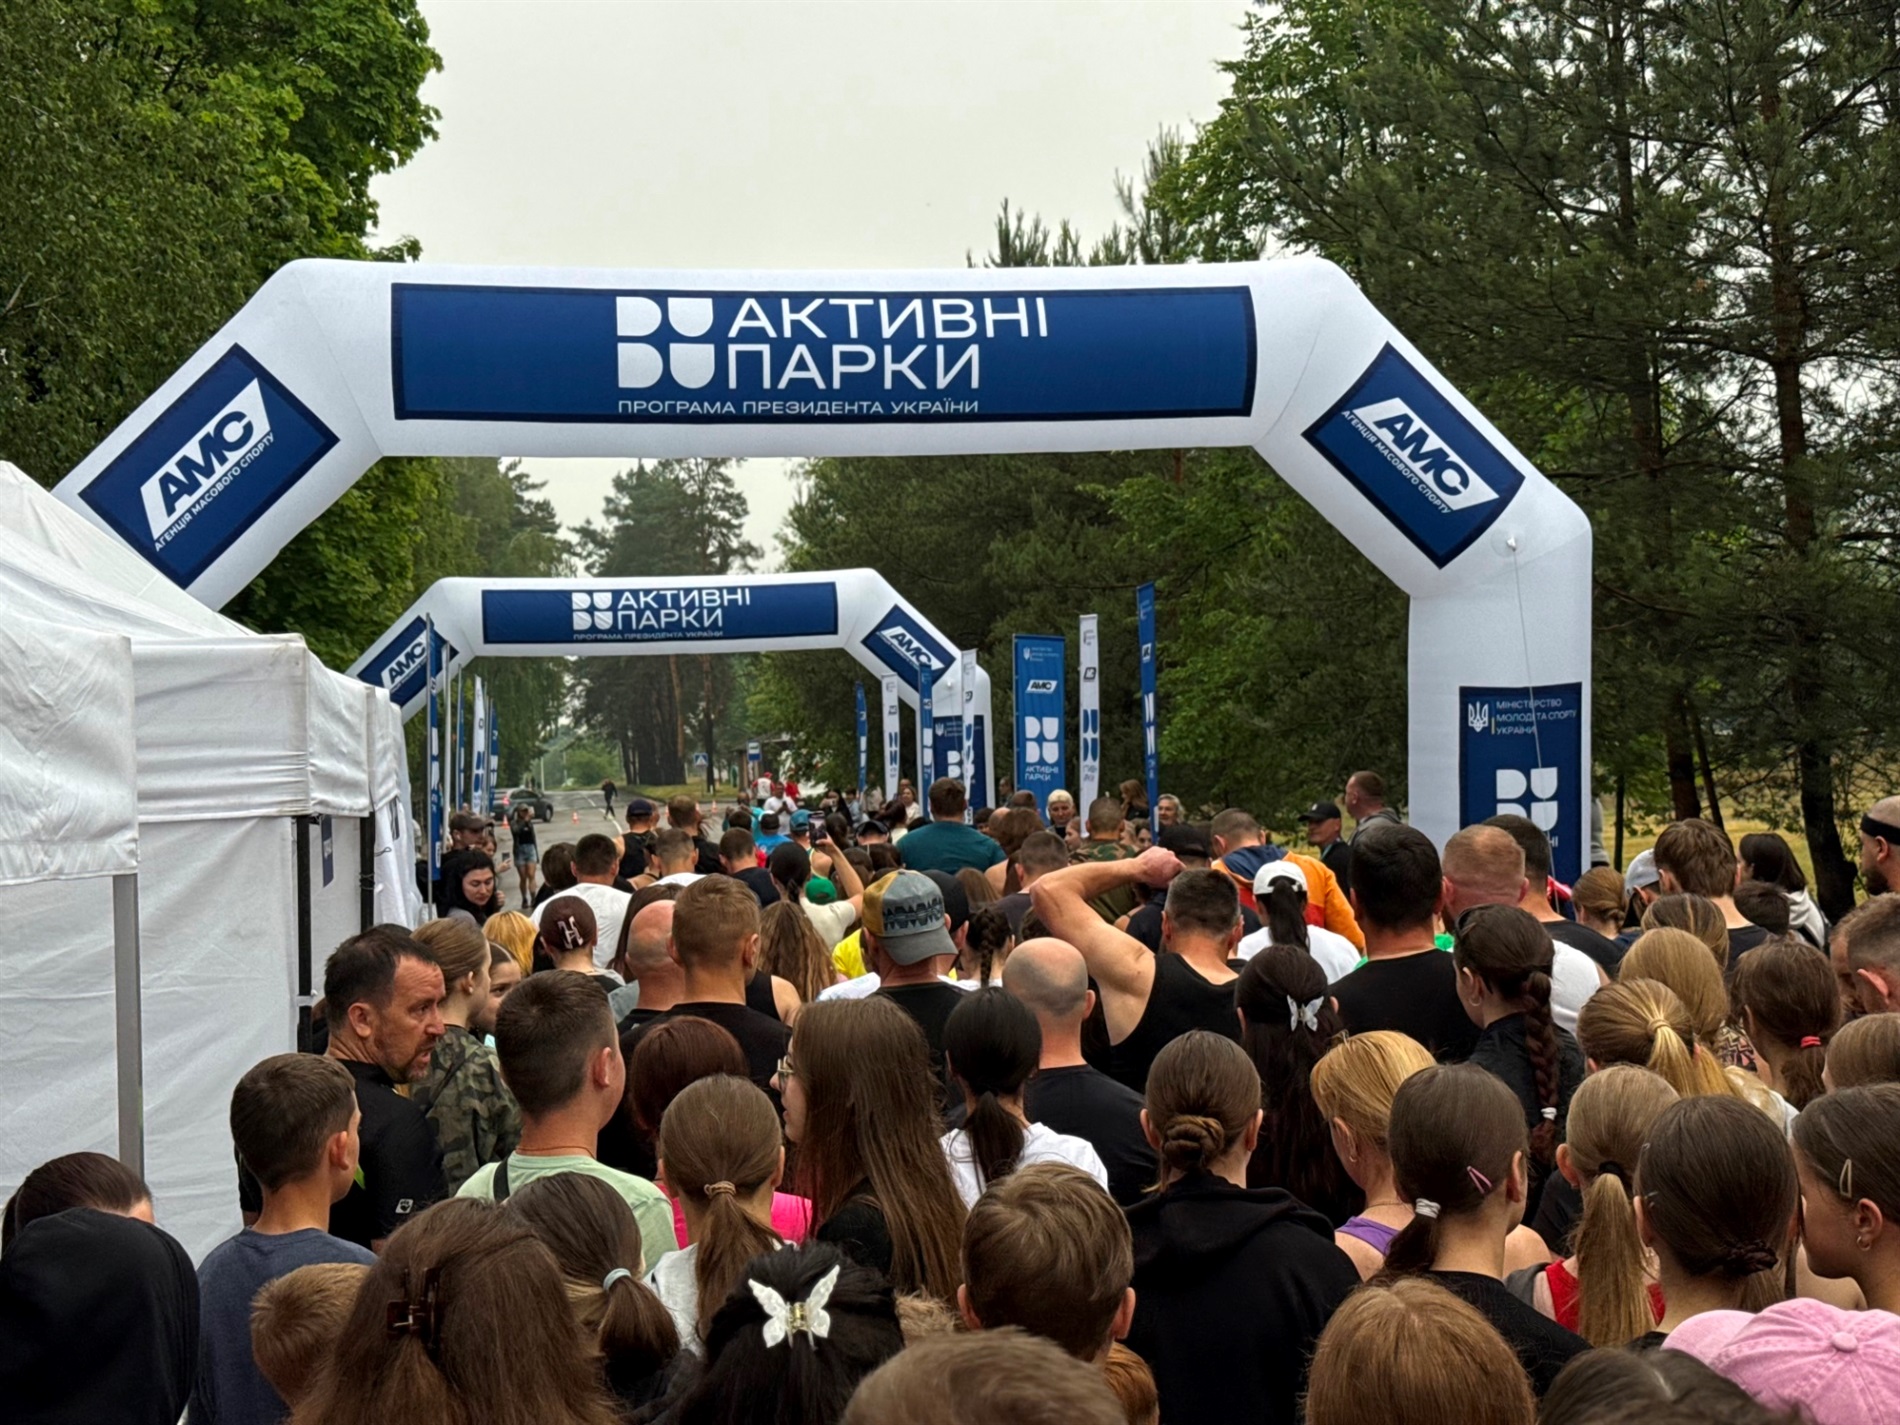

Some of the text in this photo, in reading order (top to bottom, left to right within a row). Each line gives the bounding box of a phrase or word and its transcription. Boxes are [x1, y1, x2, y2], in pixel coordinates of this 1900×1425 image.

[728, 297, 1048, 339] АКТИВНІ
[728, 343, 980, 389] ПАРКИ
[618, 398, 979, 416] ПРОГРАМА ПРЕЗИДЕНТА УКРАЇНИ
[158, 411, 254, 518] АМС
[1341, 410, 1452, 514] АГЕНЦІЯ МАСОВОГО СПОРТУ
[1372, 412, 1470, 496] АМС
[154, 432, 275, 552] АГЕНЦІЯ МАСОВОГО СПОРТУ
[617, 588, 750, 609] АКТИВНІ
[617, 608, 723, 630] ПАРКИ
[624, 631, 684, 640] ПРЕЗИДЕНТА
[685, 630, 724, 638] УКРАЇНИ
[889, 632, 932, 664] АМС
[388, 641, 426, 684] АМС
